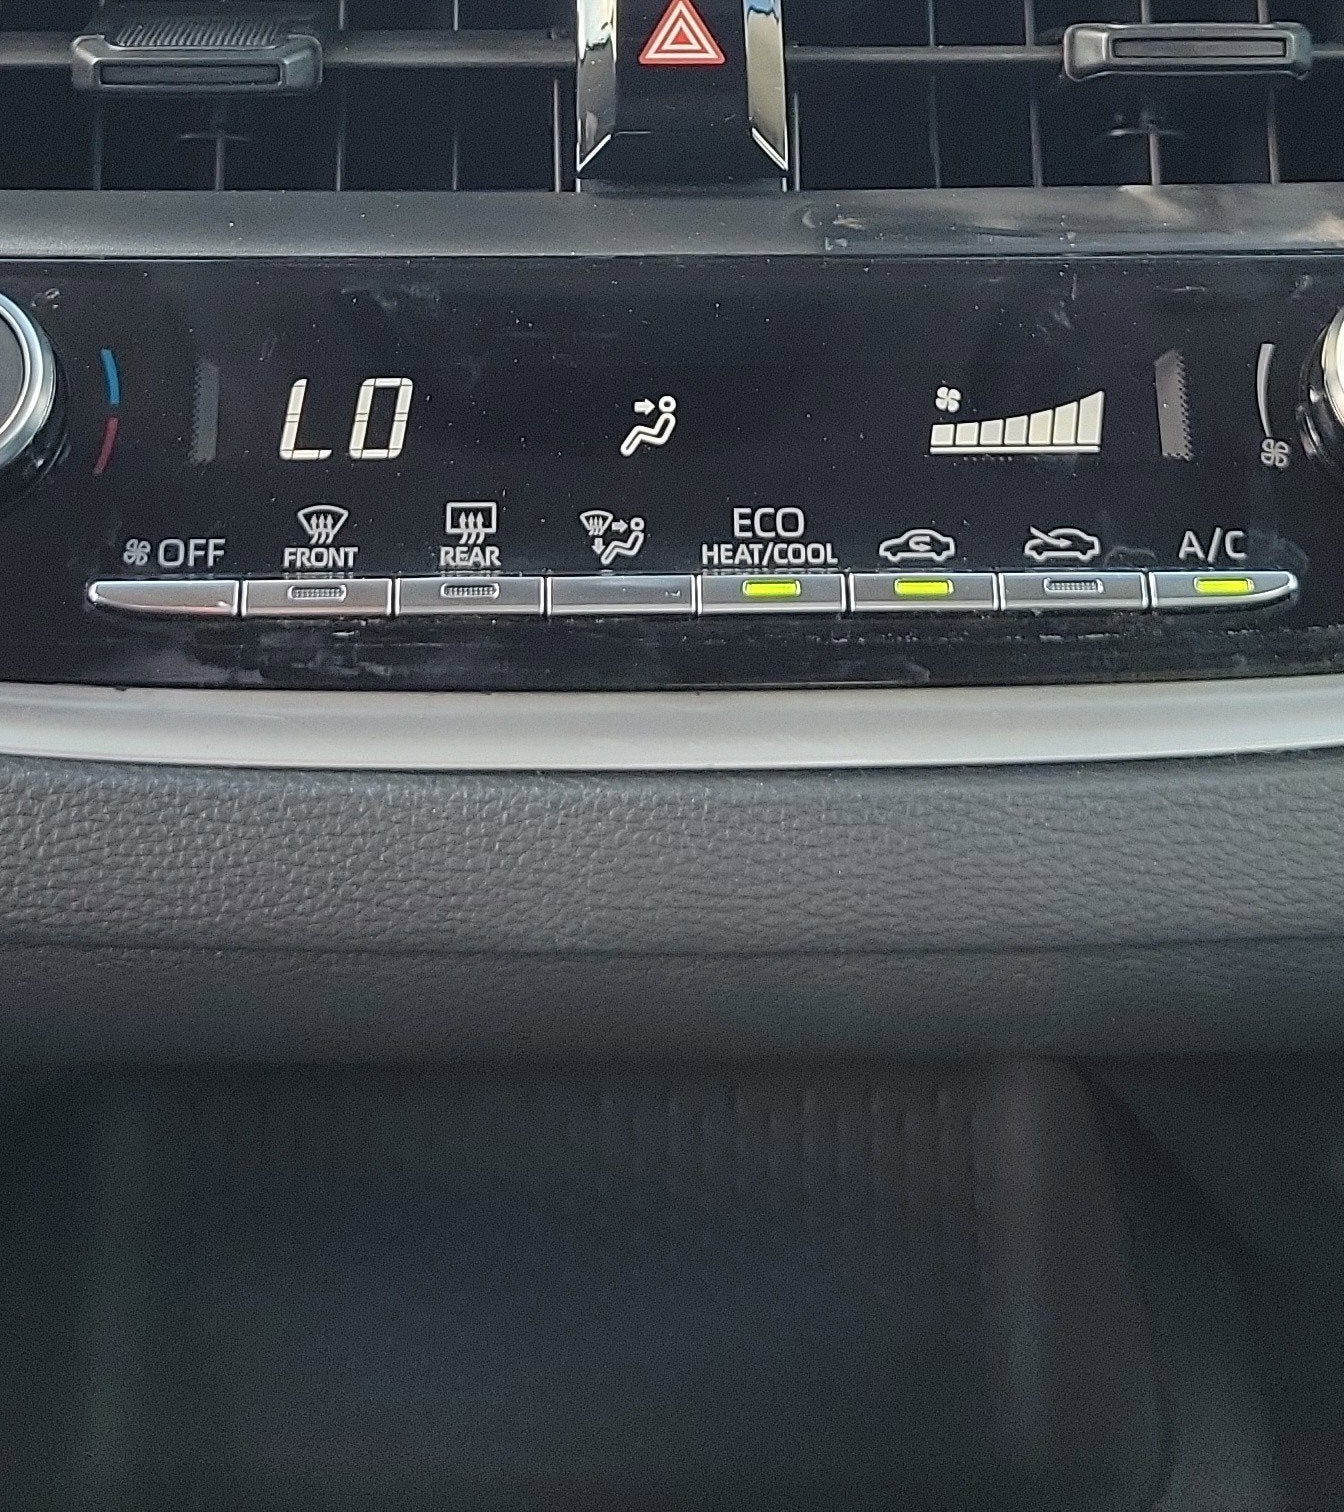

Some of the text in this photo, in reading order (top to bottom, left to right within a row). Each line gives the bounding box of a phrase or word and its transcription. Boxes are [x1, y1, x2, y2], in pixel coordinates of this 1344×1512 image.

[279, 376, 414, 460] LO
[733, 506, 806, 539] ECO
[157, 538, 227, 568] OFF
[282, 545, 359, 569] FRONT
[439, 545, 501, 567] REAR
[701, 541, 839, 566] HEAT/COOL
[1178, 528, 1247, 560] A/C
